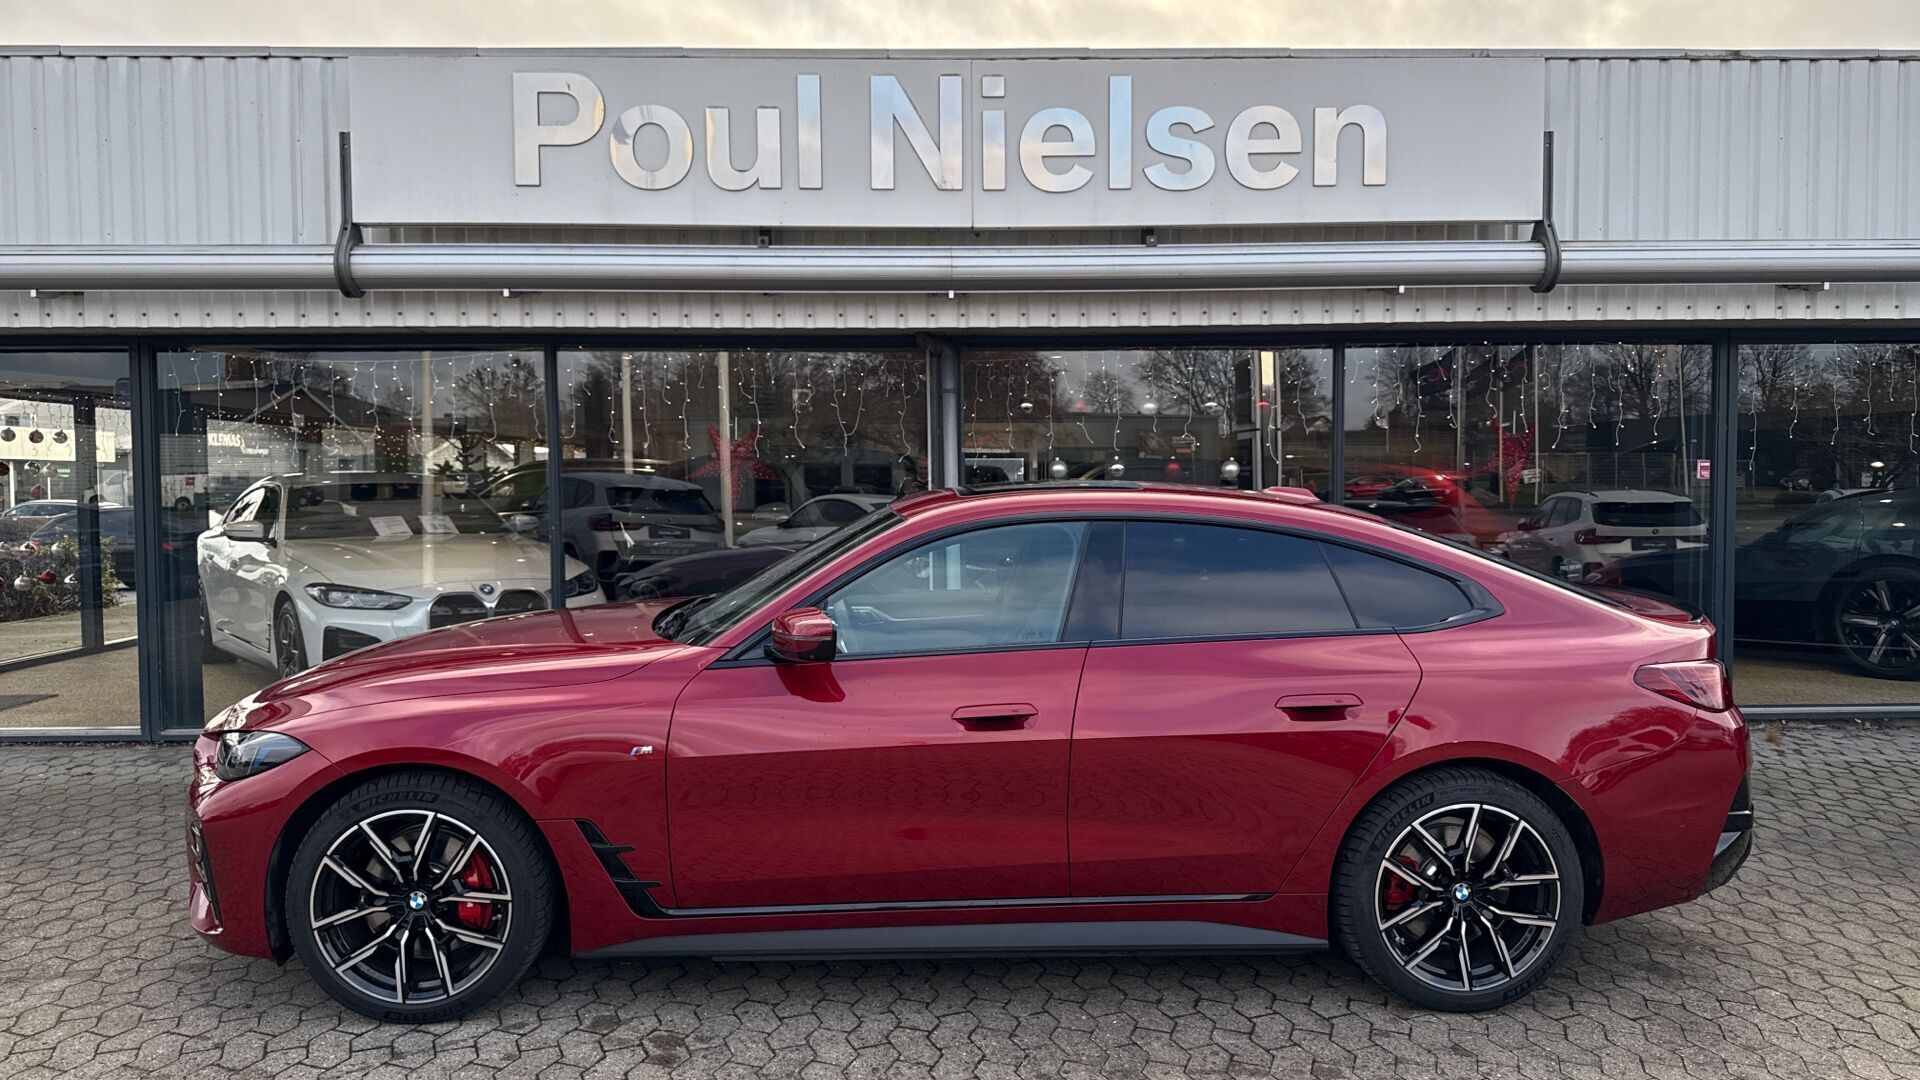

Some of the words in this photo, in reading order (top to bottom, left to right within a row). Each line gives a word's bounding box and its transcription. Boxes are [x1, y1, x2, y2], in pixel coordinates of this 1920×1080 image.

[512, 72, 822, 190] Poul
[869, 74, 1387, 192] Nielsen
[359, 791, 437, 810] MICHELIN
[1376, 794, 1432, 847] MICHELIN
